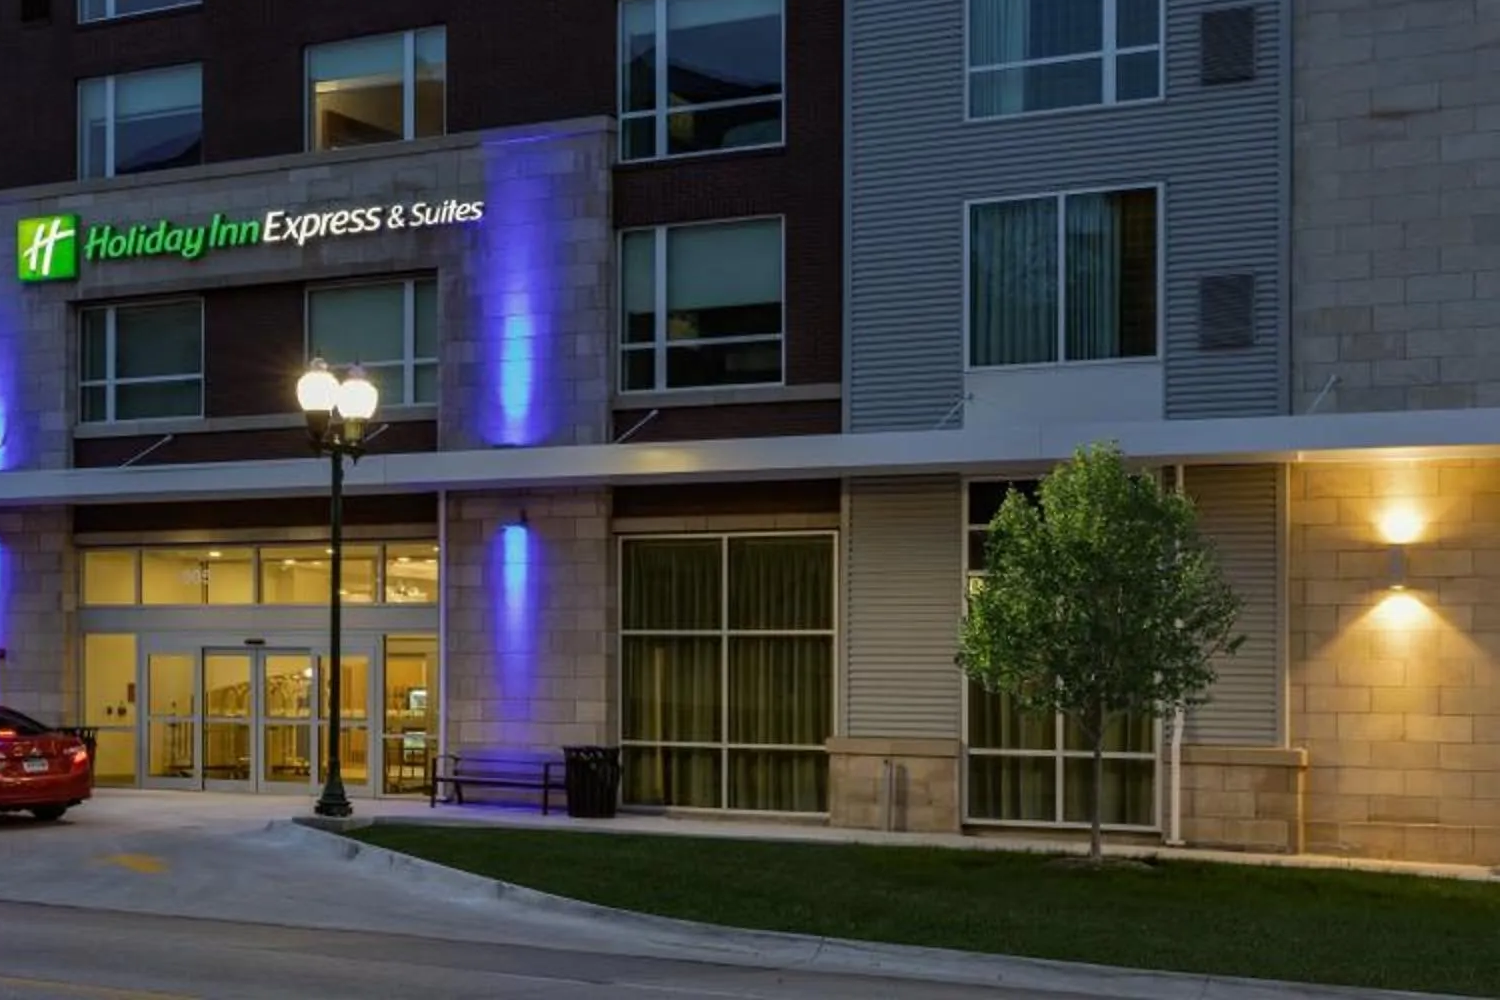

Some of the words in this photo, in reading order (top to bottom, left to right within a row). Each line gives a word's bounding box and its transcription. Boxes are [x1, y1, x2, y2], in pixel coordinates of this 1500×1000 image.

[85, 220, 204, 260] Holiday
[208, 213, 261, 247] Inn
[262, 207, 381, 245] Express
[387, 206, 406, 228] &
[411, 199, 484, 226] Suites
